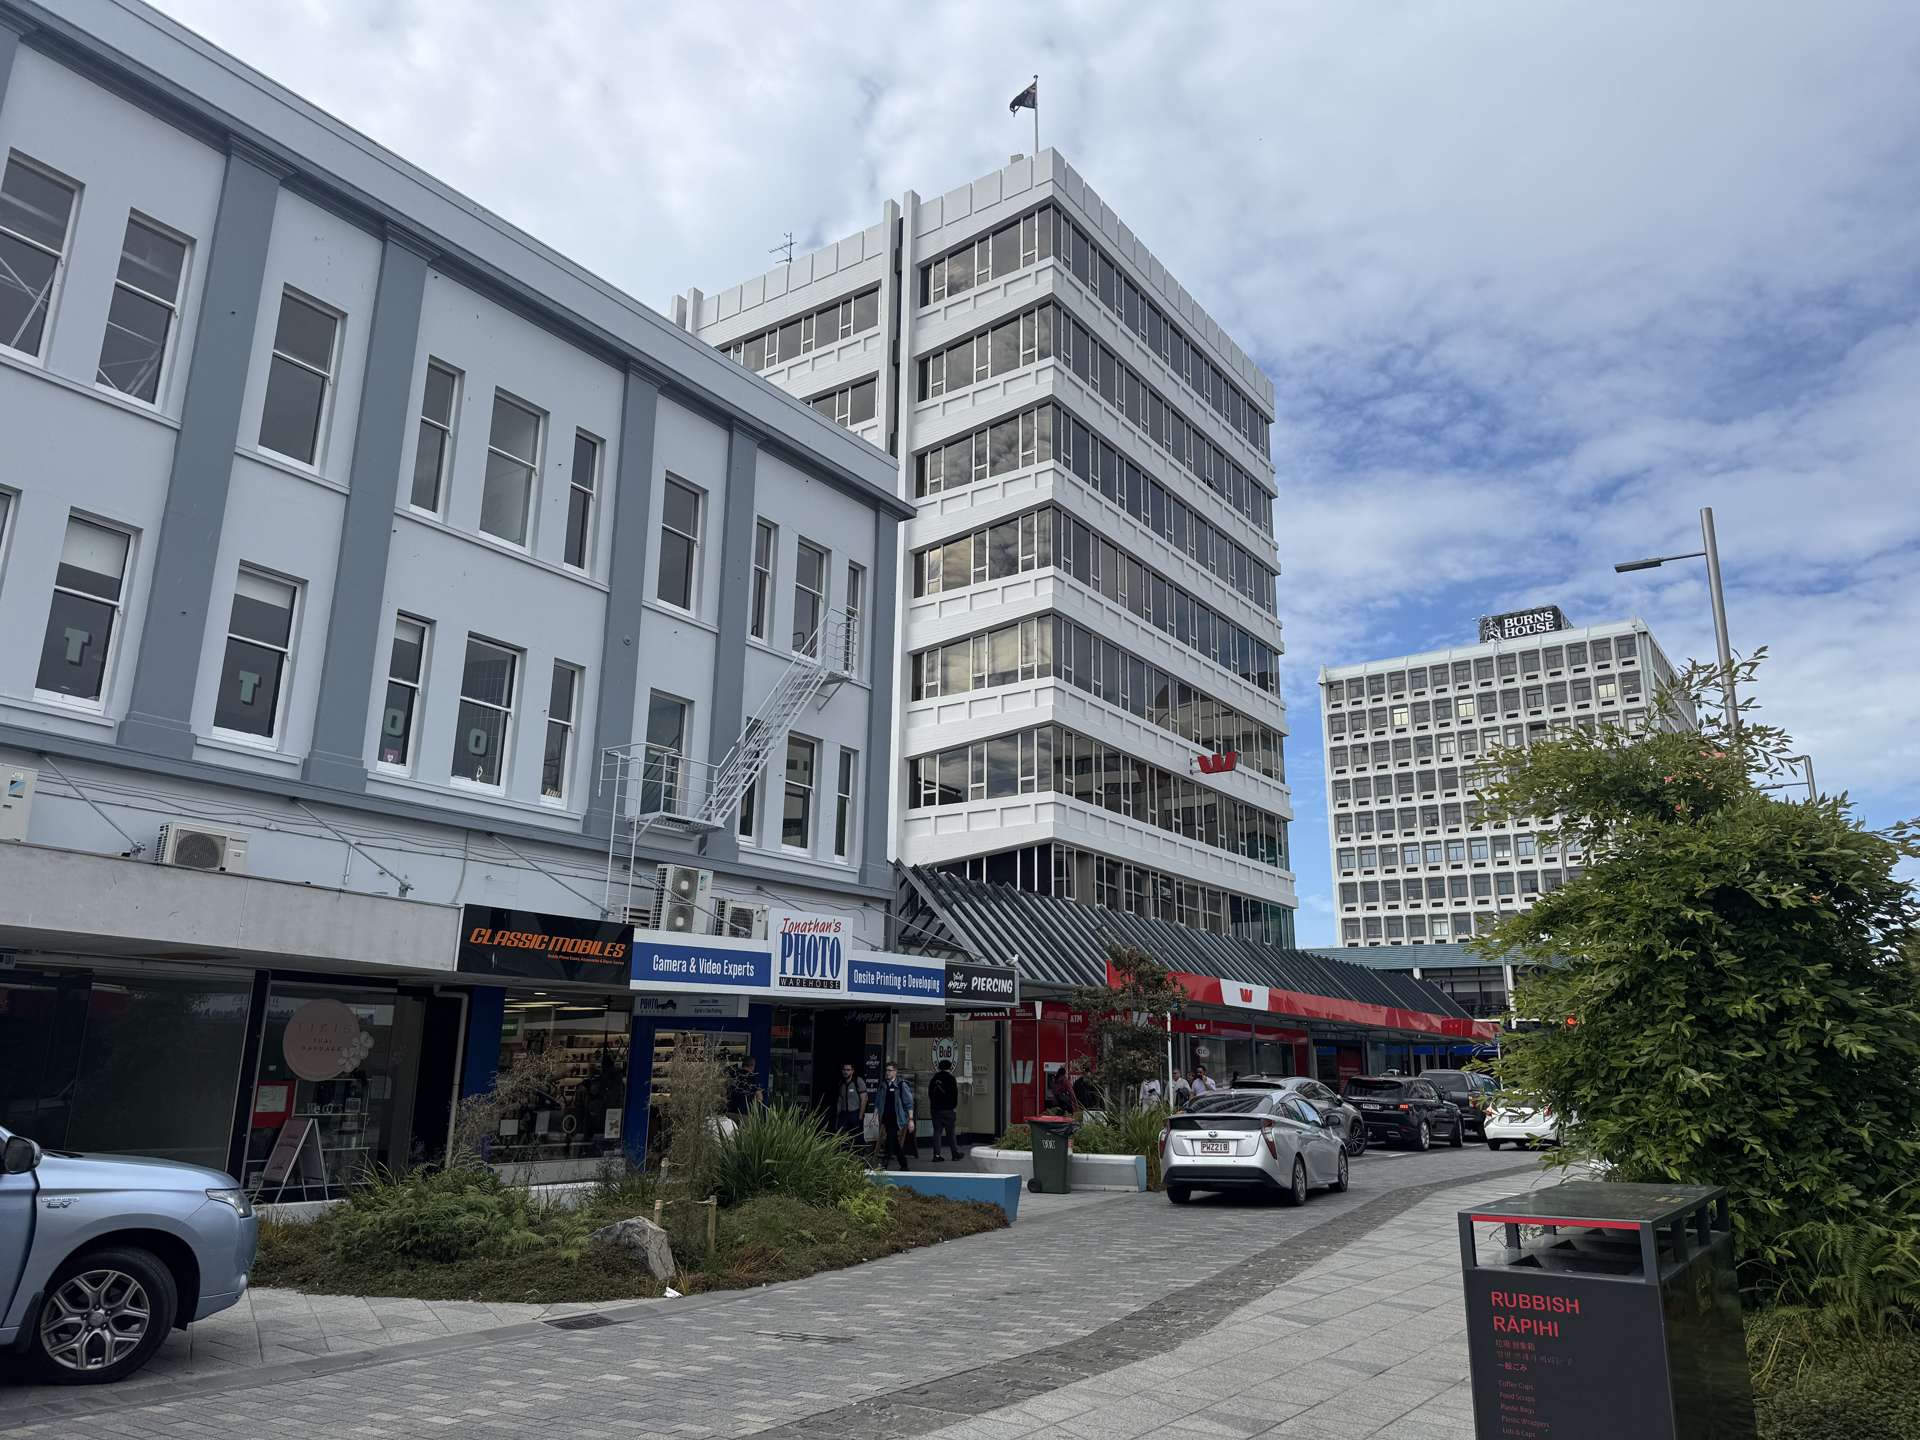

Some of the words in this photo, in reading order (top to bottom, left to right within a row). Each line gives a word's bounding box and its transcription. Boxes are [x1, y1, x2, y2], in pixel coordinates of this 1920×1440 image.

[1504, 611, 1554, 628] BURNS
[1505, 621, 1555, 638] HOUSE
[780, 917, 842, 934] Jonathan's
[470, 927, 549, 950] CLASSIC
[548, 937, 626, 958] MOBILES
[779, 932, 841, 979] PHOTO
[652, 954, 687, 972] Camera
[689, 957, 696, 973] &
[699, 958, 721, 975] Video
[723, 960, 755, 979] Experts
[780, 978, 841, 989] WAREHOUSE
[853, 969, 875, 985] Onsite
[876, 971, 901, 990] Printing
[902, 975, 907, 987] &
[908, 974, 940, 993] Developing
[970, 976, 1013, 994] PIERCING
[1070, 1015, 1082, 1024] ATM
[1491, 1291, 1580, 1314] RUBBISH
